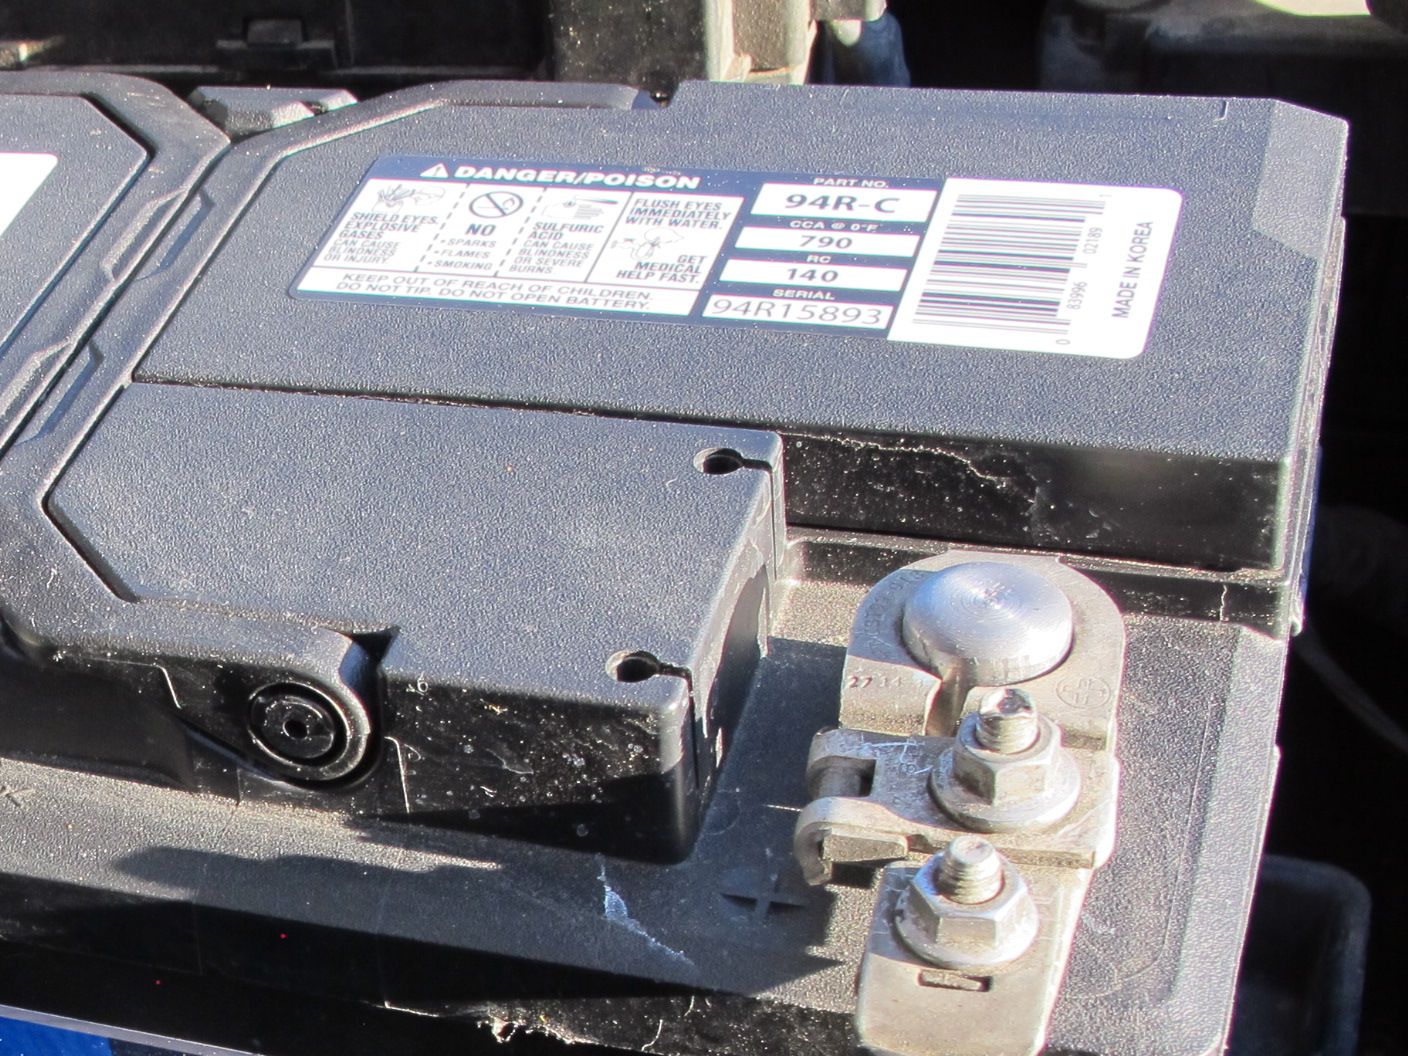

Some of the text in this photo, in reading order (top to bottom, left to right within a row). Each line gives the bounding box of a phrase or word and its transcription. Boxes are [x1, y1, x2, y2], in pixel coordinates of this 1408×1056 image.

[454, 165, 701, 190] DANGER/POISON
[813, 177, 890, 189] PART NO.
[634, 197, 724, 213] FLUSH EYES
[785, 192, 903, 215] 94R-C
[350, 211, 401, 223] SHIELD
[628, 206, 732, 221] IMMEDIATELY
[344, 220, 422, 233] EXPLOSIVE
[465, 223, 497, 237] NO
[532, 221, 605, 235] SULFURIC
[625, 216, 724, 230] WITH WATER.
[790, 219, 831, 231] CCA
[338, 229, 385, 240] GASES
[527, 229, 565, 242] ACID
[333, 238, 401, 250] CAN CAUSE
[522, 239, 595, 252] CAN CAUSE
[799, 234, 854, 250] 790
[323, 253, 342, 262] OR
[328, 246, 397, 257] BLINDNESS
[518, 247, 590, 260] BLINDNESS
[513, 255, 585, 269] OR SEVERE
[677, 254, 708, 265] GET
[807, 254, 832, 264] RC
[633, 261, 703, 275] MEDICAL
[787, 266, 840, 283] 140
[1066, 280, 1088, 311] 83996
[1082, 226, 1104, 255] 02189
[1111, 221, 1154, 320] MADE IN KOREA
[616, 269, 701, 284] HELP FAST.
[343, 272, 655, 301] KEEP OUT OF REACH OF CHILDREN.
[335, 282, 652, 311] DO NOT TIP. DO NOT OPEN BATTERY.
[773, 288, 837, 301] SERIAL
[711, 297, 884, 326] 94R15893
